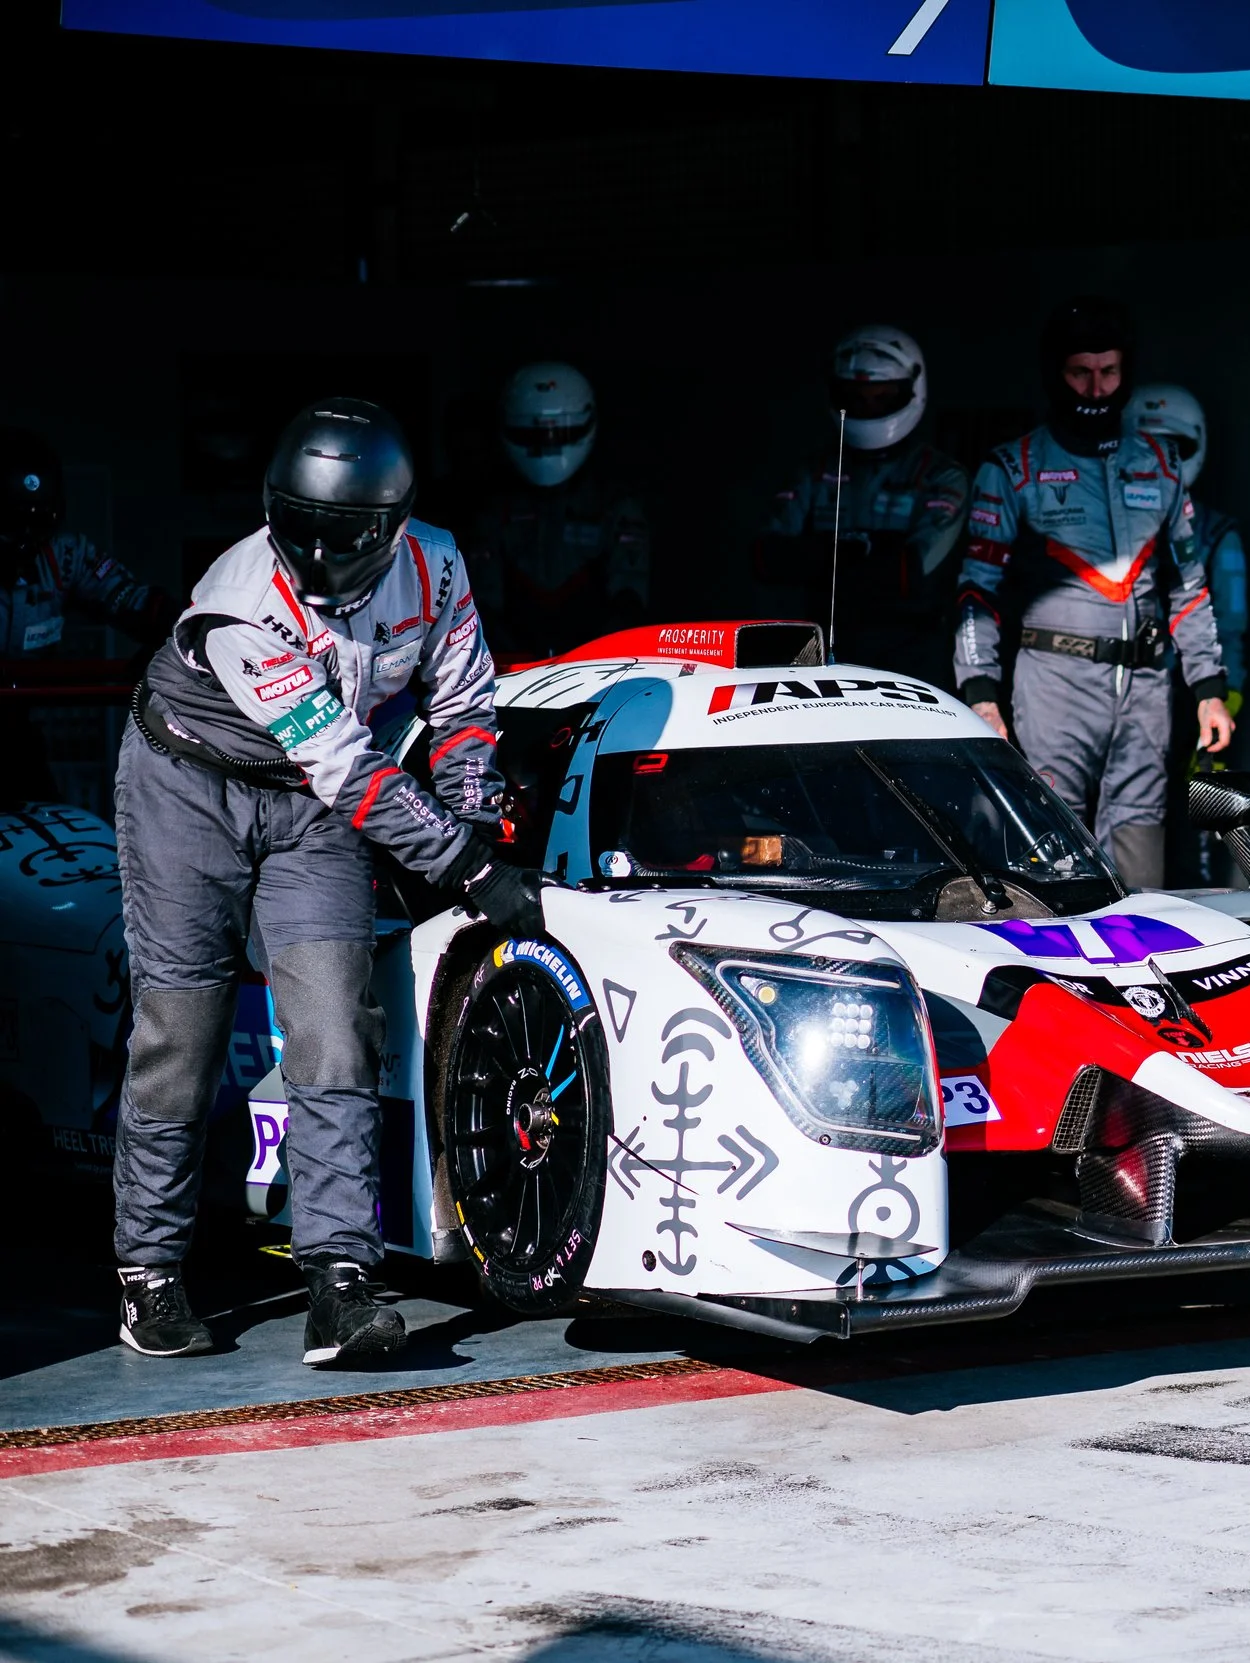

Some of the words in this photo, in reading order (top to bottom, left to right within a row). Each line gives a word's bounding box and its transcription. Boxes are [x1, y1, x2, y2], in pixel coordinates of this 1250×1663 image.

[435, 555, 455, 608] HRX
[261, 614, 305, 652] HRX
[658, 628, 726, 645] PROSPERITY
[657, 647, 687, 656] INVESTMENT
[689, 648, 724, 657] MANAGEMENT
[259, 668, 312, 701] MOTUL
[765, 679, 940, 705] APS
[305, 710, 326, 730] PIT
[713, 704, 800, 726] INDEPENDENT
[802, 700, 869, 710] EUROPEAN
[897, 702, 958, 719] SPECIALIST
[515, 941, 582, 1001] MICHELIN
[1187, 1060, 1242, 1071] RACING
[253, 1113, 289, 1170] P
[126, 1274, 147, 1282] HRX
[128, 1302, 139, 1325] HRX
